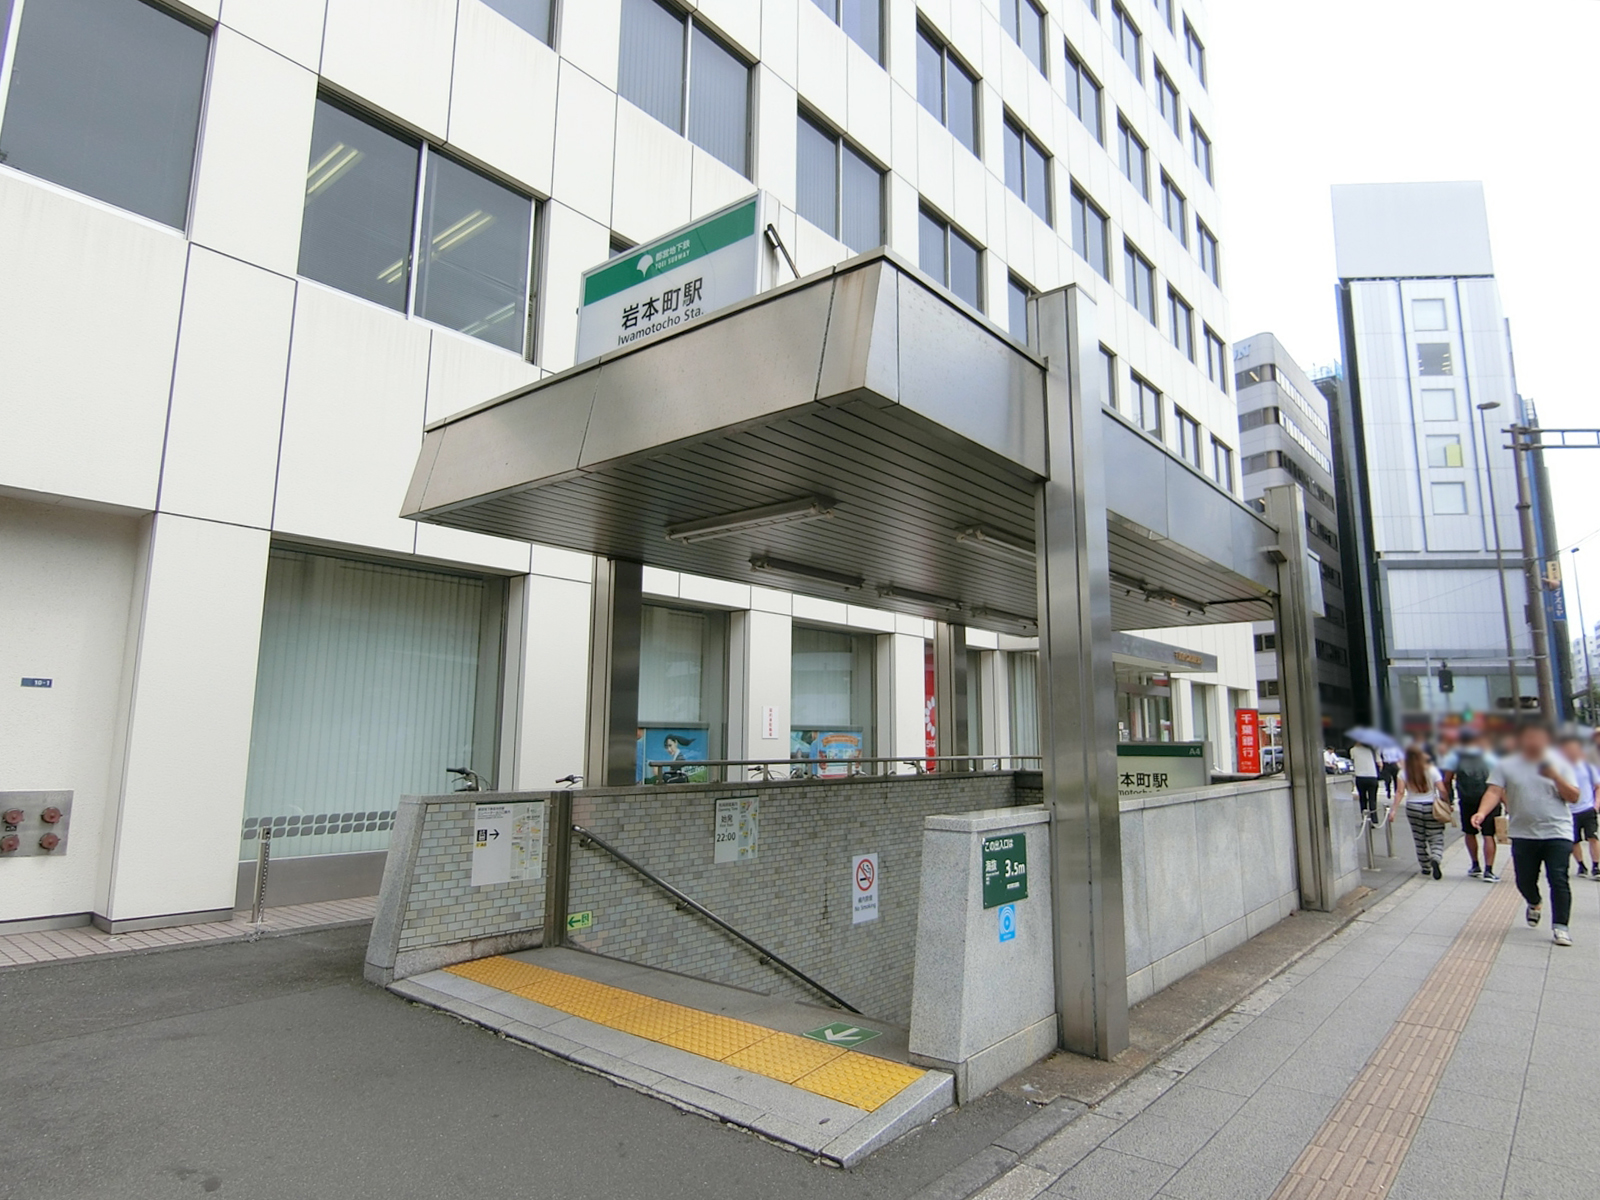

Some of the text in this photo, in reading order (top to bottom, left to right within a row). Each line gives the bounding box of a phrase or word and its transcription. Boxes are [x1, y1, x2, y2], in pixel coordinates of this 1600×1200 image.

[655, 239, 690, 262] 都営地下鉄
[655, 250, 690, 270] TOEI SUBWAY
[621, 277, 703, 330] 岩本町駅
[617, 306, 704, 346] Iwamotocho Sta.
[1241, 714, 1253, 758] 千葉銀行
[1117, 772, 1168, 788] 本町駅
[717, 832, 736, 842] 22:00
[1005, 859, 1026, 878] 3.5m
[860, 902, 876, 911] Smoking
